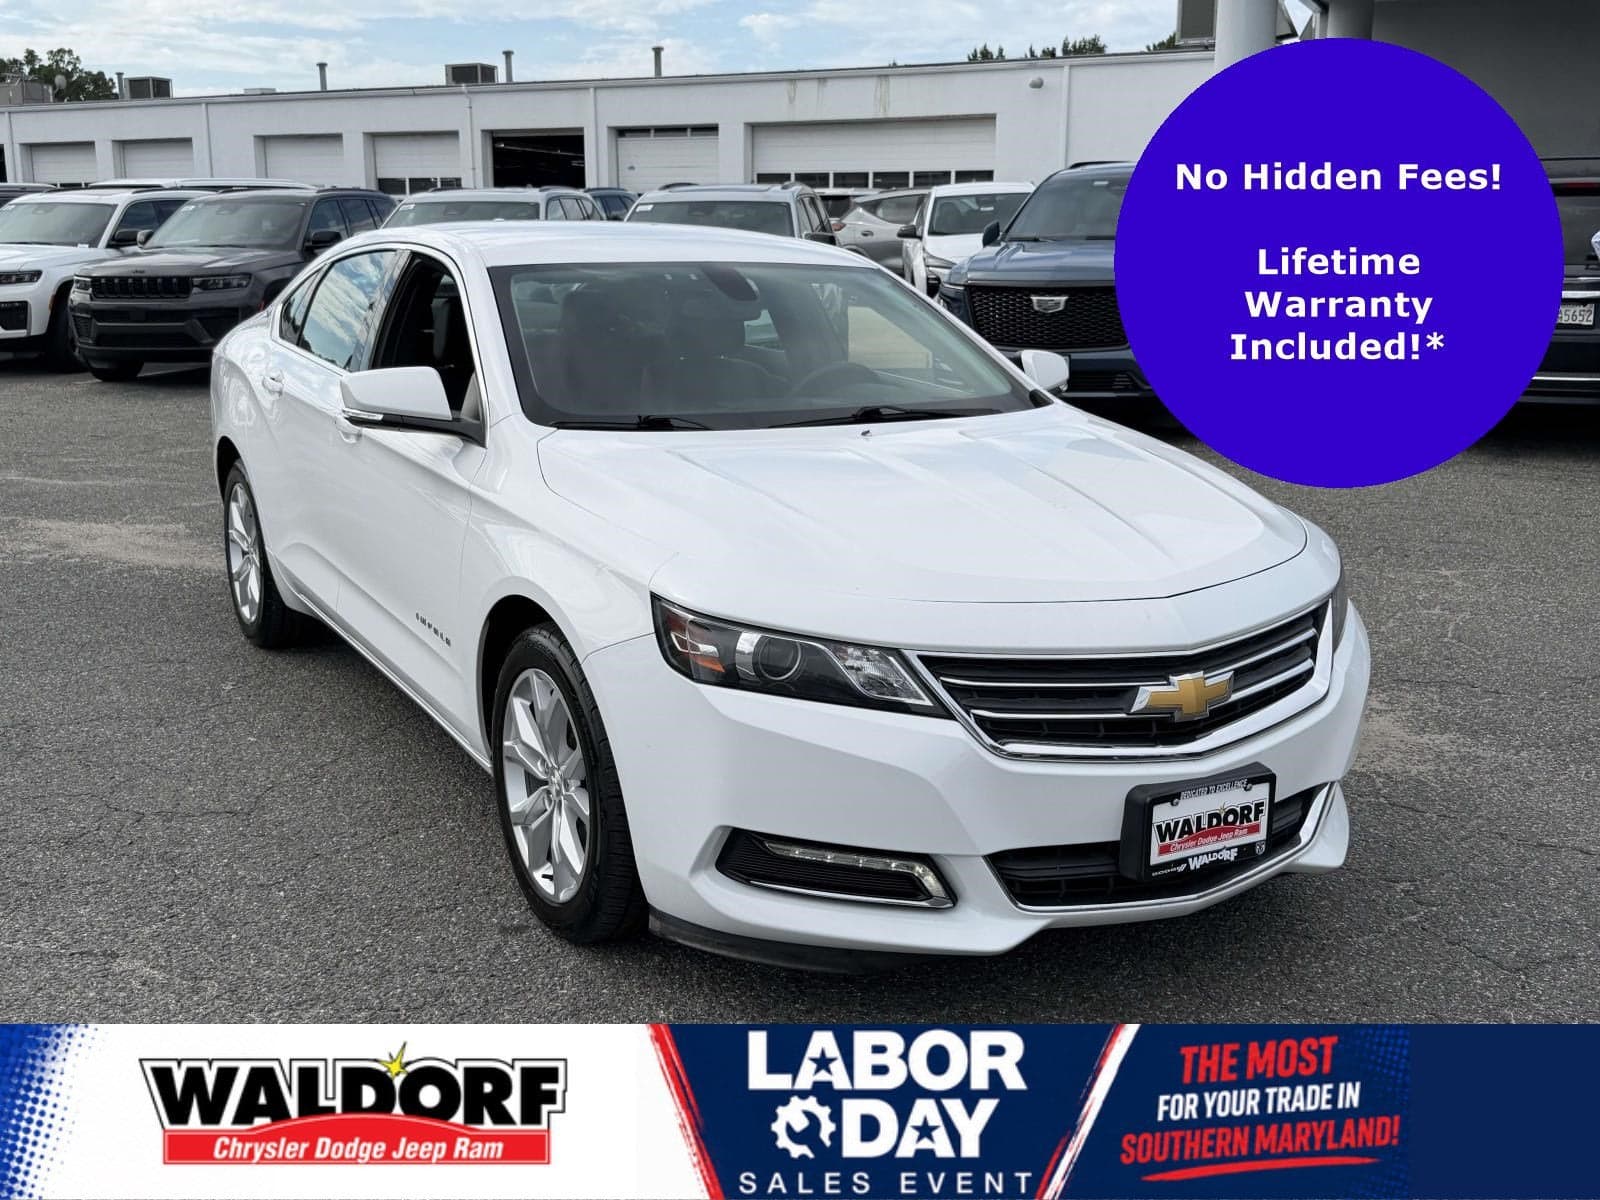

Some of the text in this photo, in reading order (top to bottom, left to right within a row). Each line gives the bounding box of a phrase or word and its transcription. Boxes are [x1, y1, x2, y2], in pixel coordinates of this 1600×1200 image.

[1155, 801, 1265, 843] WALDORF
[1170, 838, 1197, 852] Chrysler
[1188, 847, 1239, 871] WALDORF
